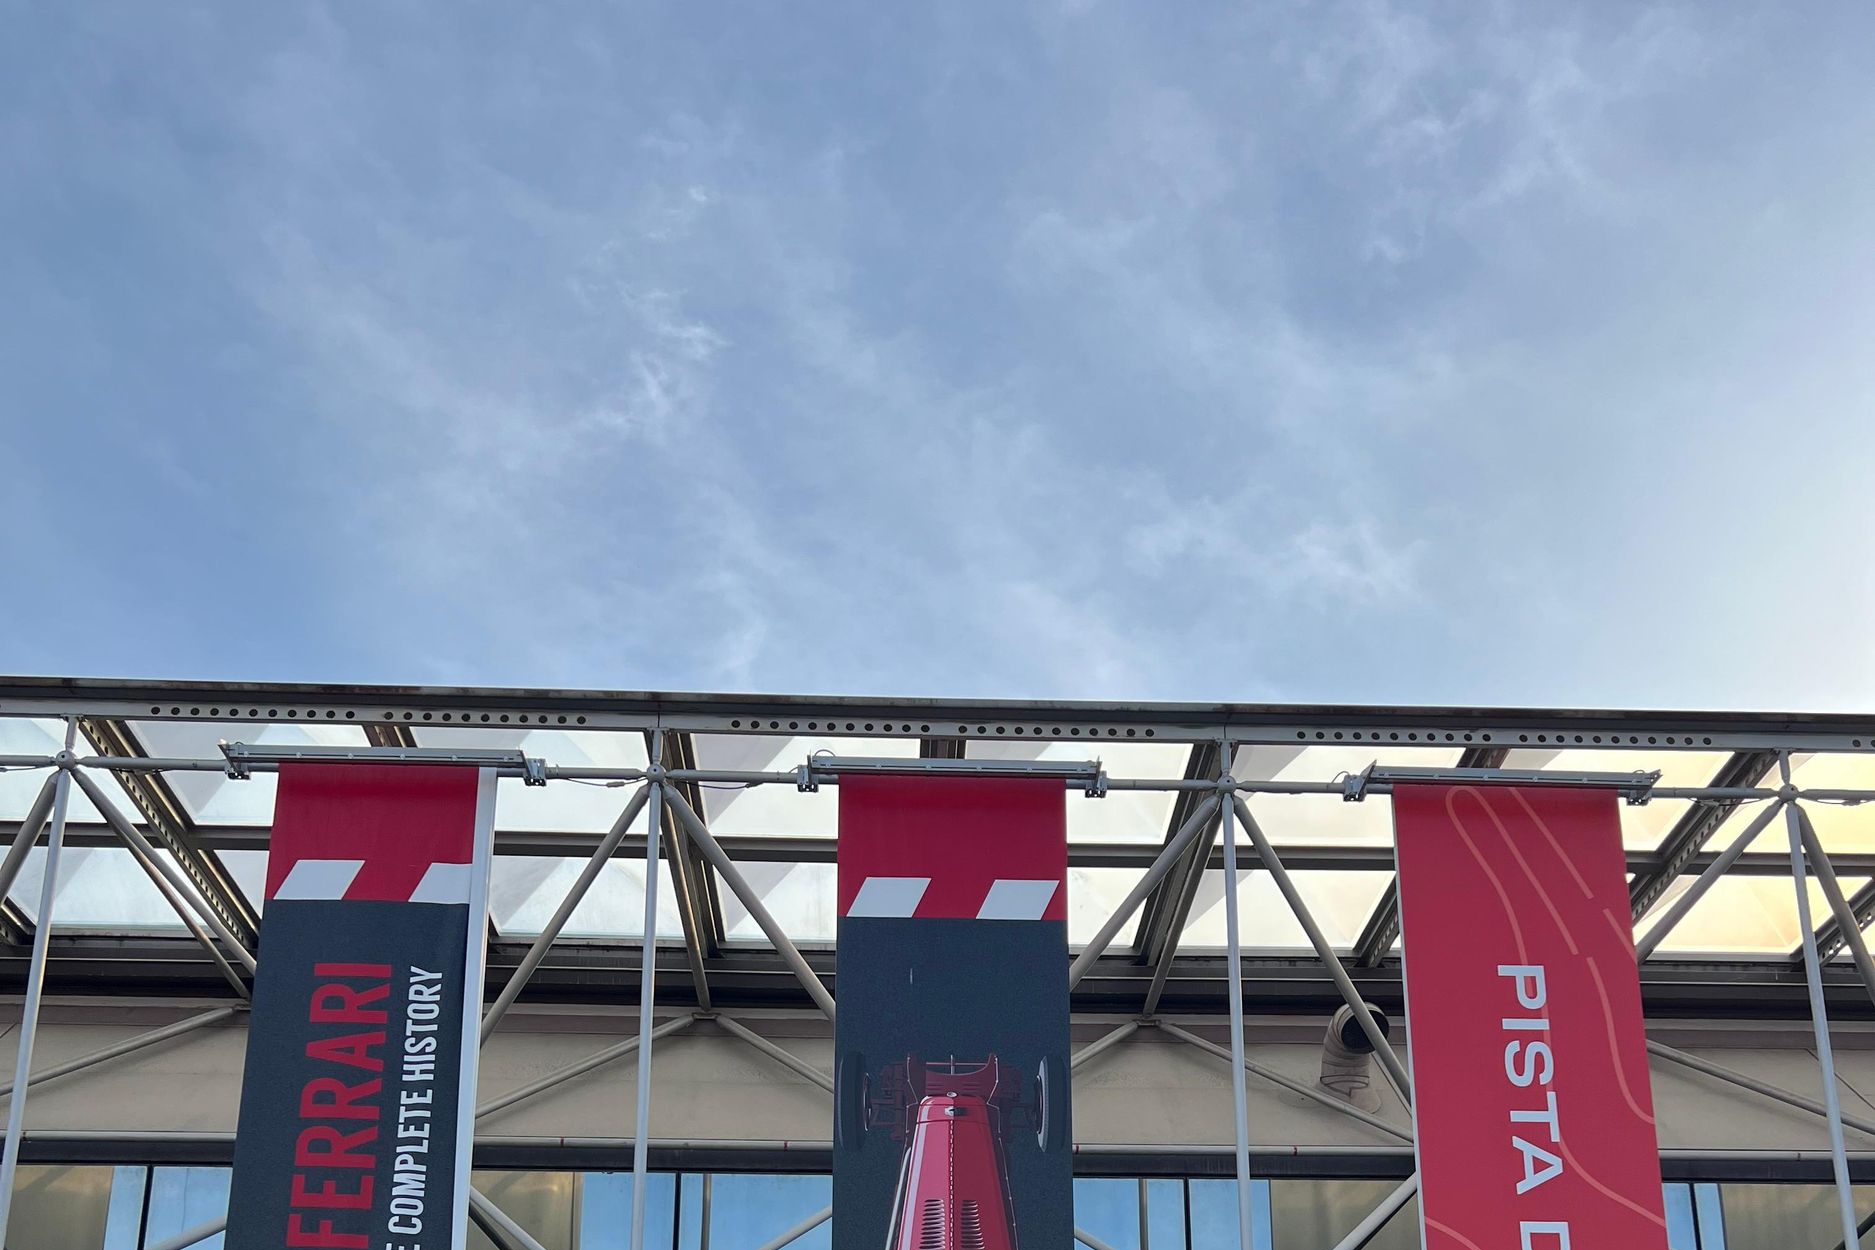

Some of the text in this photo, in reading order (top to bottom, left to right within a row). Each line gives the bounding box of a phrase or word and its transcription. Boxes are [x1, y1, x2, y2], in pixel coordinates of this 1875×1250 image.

[287, 963, 392, 1249] FERRARI
[402, 965, 443, 1081] HISTORY
[1497, 964, 1564, 1195] PISTA
[387, 1089, 433, 1235] COMPLETE
